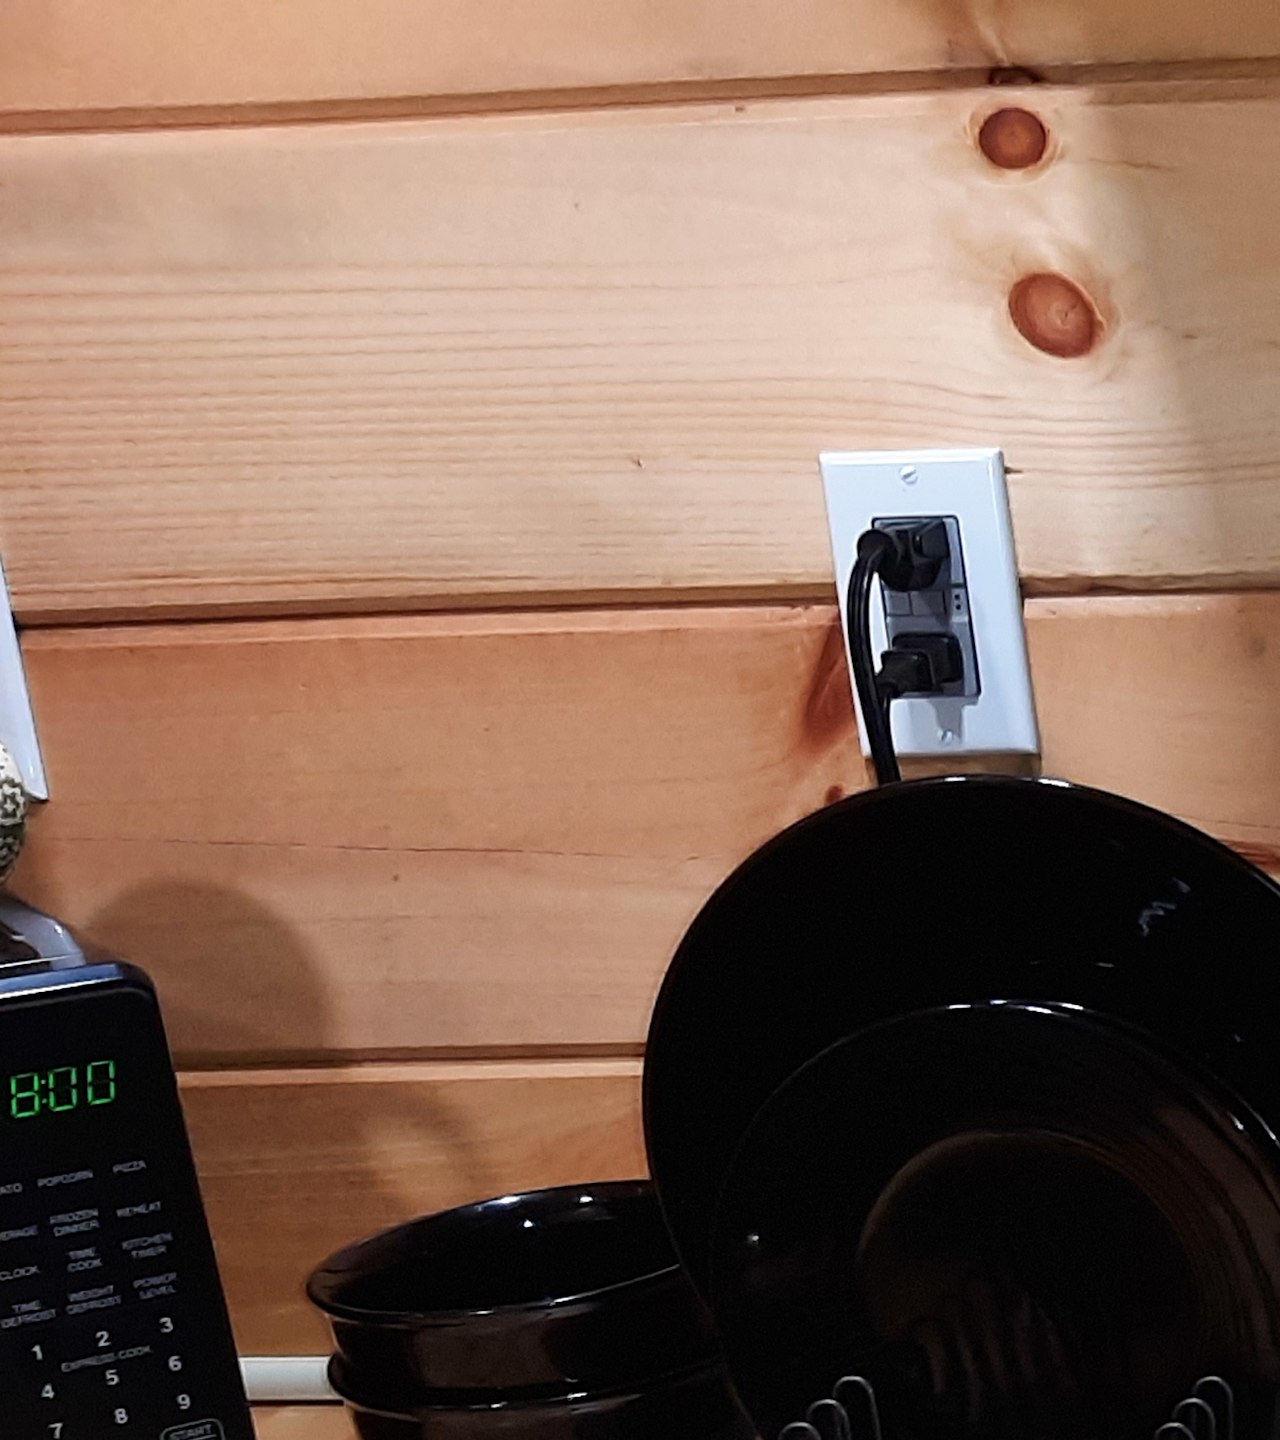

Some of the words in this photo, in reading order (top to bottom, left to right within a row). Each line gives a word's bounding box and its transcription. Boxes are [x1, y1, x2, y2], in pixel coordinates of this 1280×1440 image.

[11, 1061, 115, 1118] 8:00
[159, 1317, 174, 1333] 3
[95, 1330, 111, 1347] 2
[31, 1344, 43, 1360] 1
[168, 1355, 182, 1371] 6
[105, 1369, 120, 1386] 5
[41, 1383, 55, 1399] 4
[176, 1393, 191, 1410] 9
[114, 1407, 128, 1424] 8
[48, 1422, 63, 1440] 7
